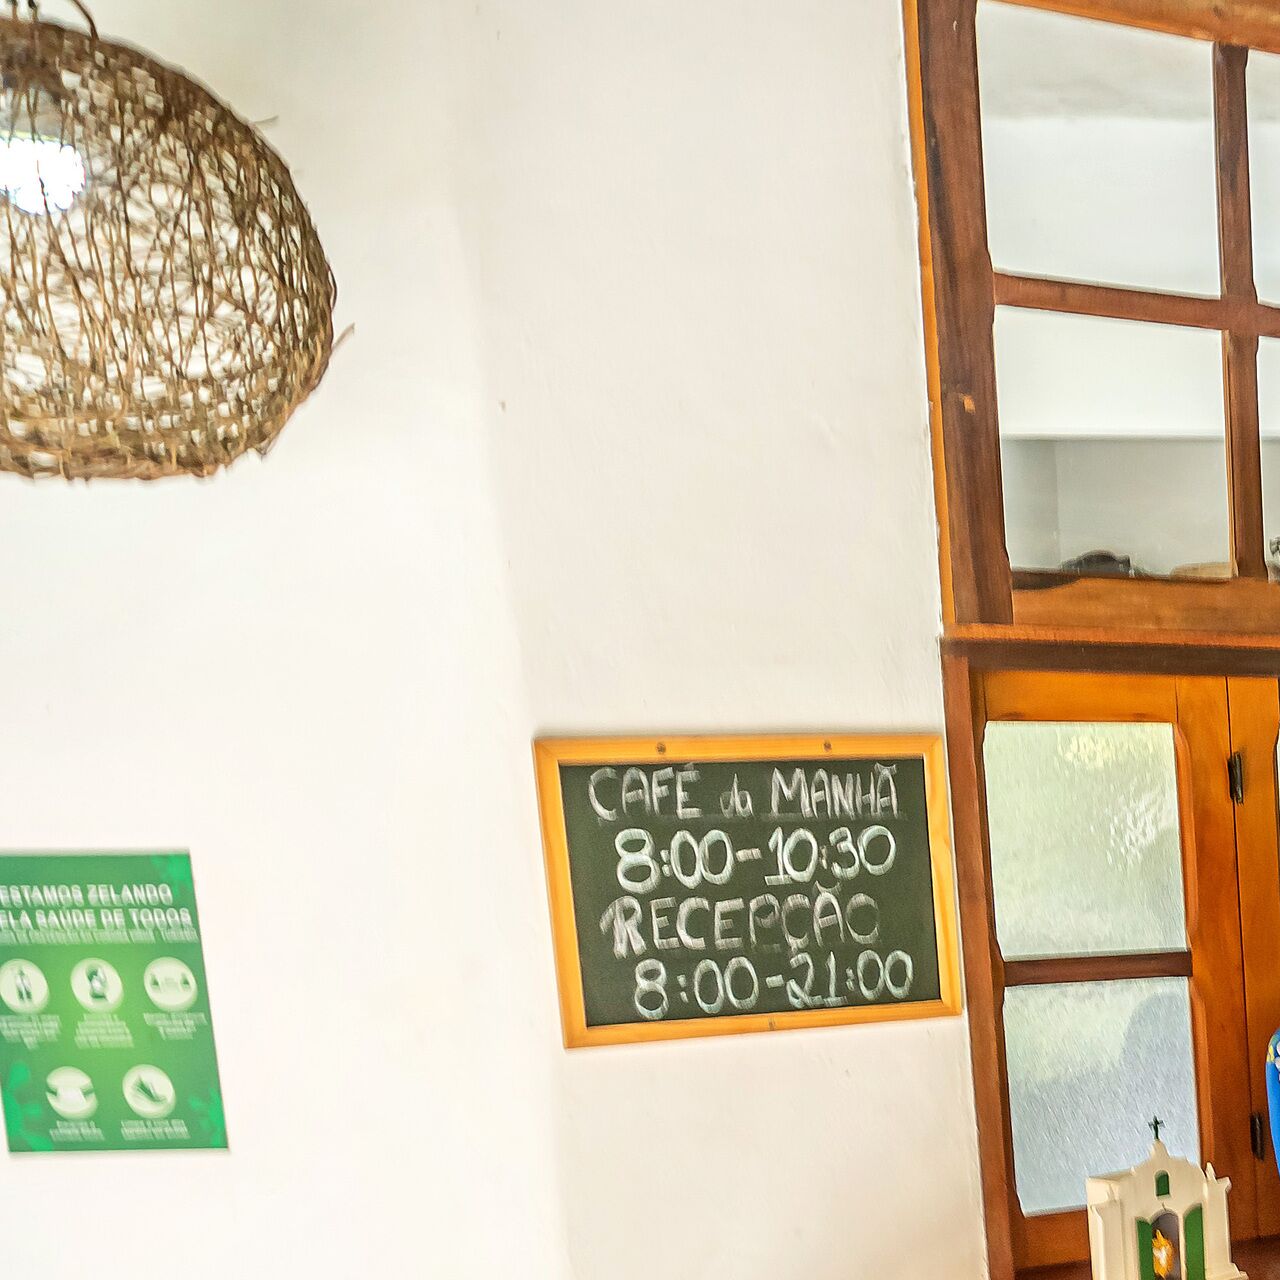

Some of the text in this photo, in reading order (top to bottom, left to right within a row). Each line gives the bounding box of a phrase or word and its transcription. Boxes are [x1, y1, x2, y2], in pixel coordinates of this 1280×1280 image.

[589, 763, 701, 821] CAFÉ
[771, 762, 898, 819] MANHÃ
[87, 883, 173, 906] ZELANDO
[101, 908, 127, 930] DE
[129, 907, 193, 931] TODOS
[600, 881, 881, 958] RECEPÇÃO
